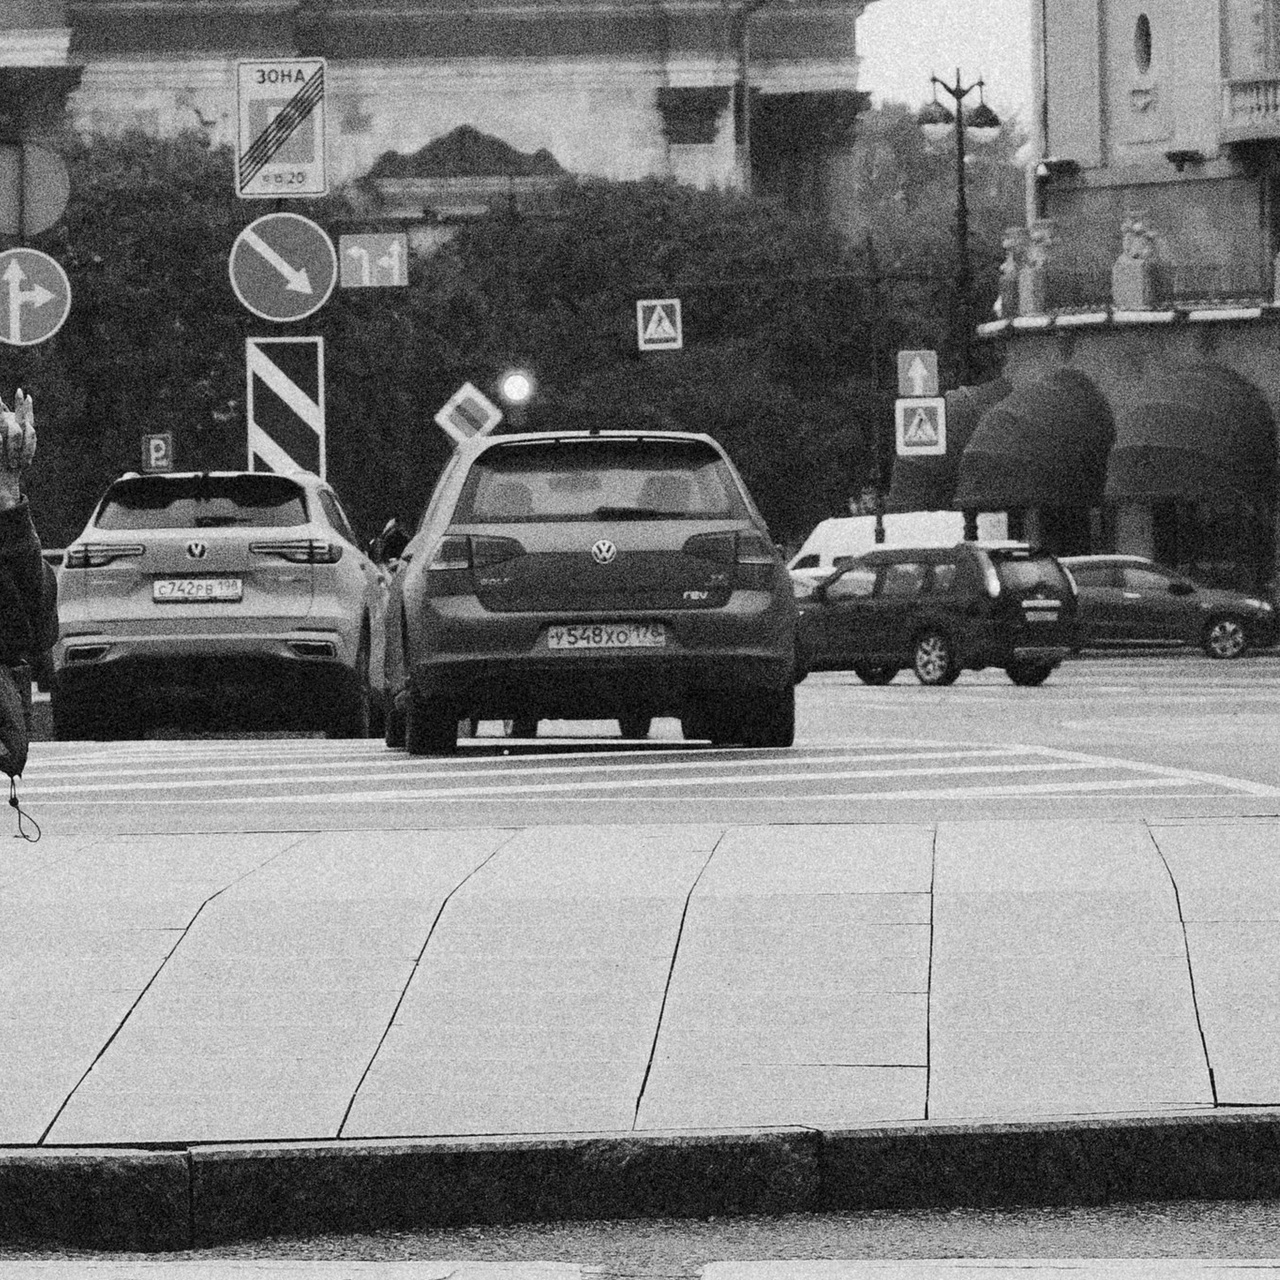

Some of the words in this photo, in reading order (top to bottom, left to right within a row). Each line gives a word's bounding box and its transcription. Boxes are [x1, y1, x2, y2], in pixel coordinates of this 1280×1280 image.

[255, 68, 306, 85] ЗОНА
[287, 171, 306, 185] 20
[149, 438, 166, 467] P
[555, 626, 629, 645] У548ХО
